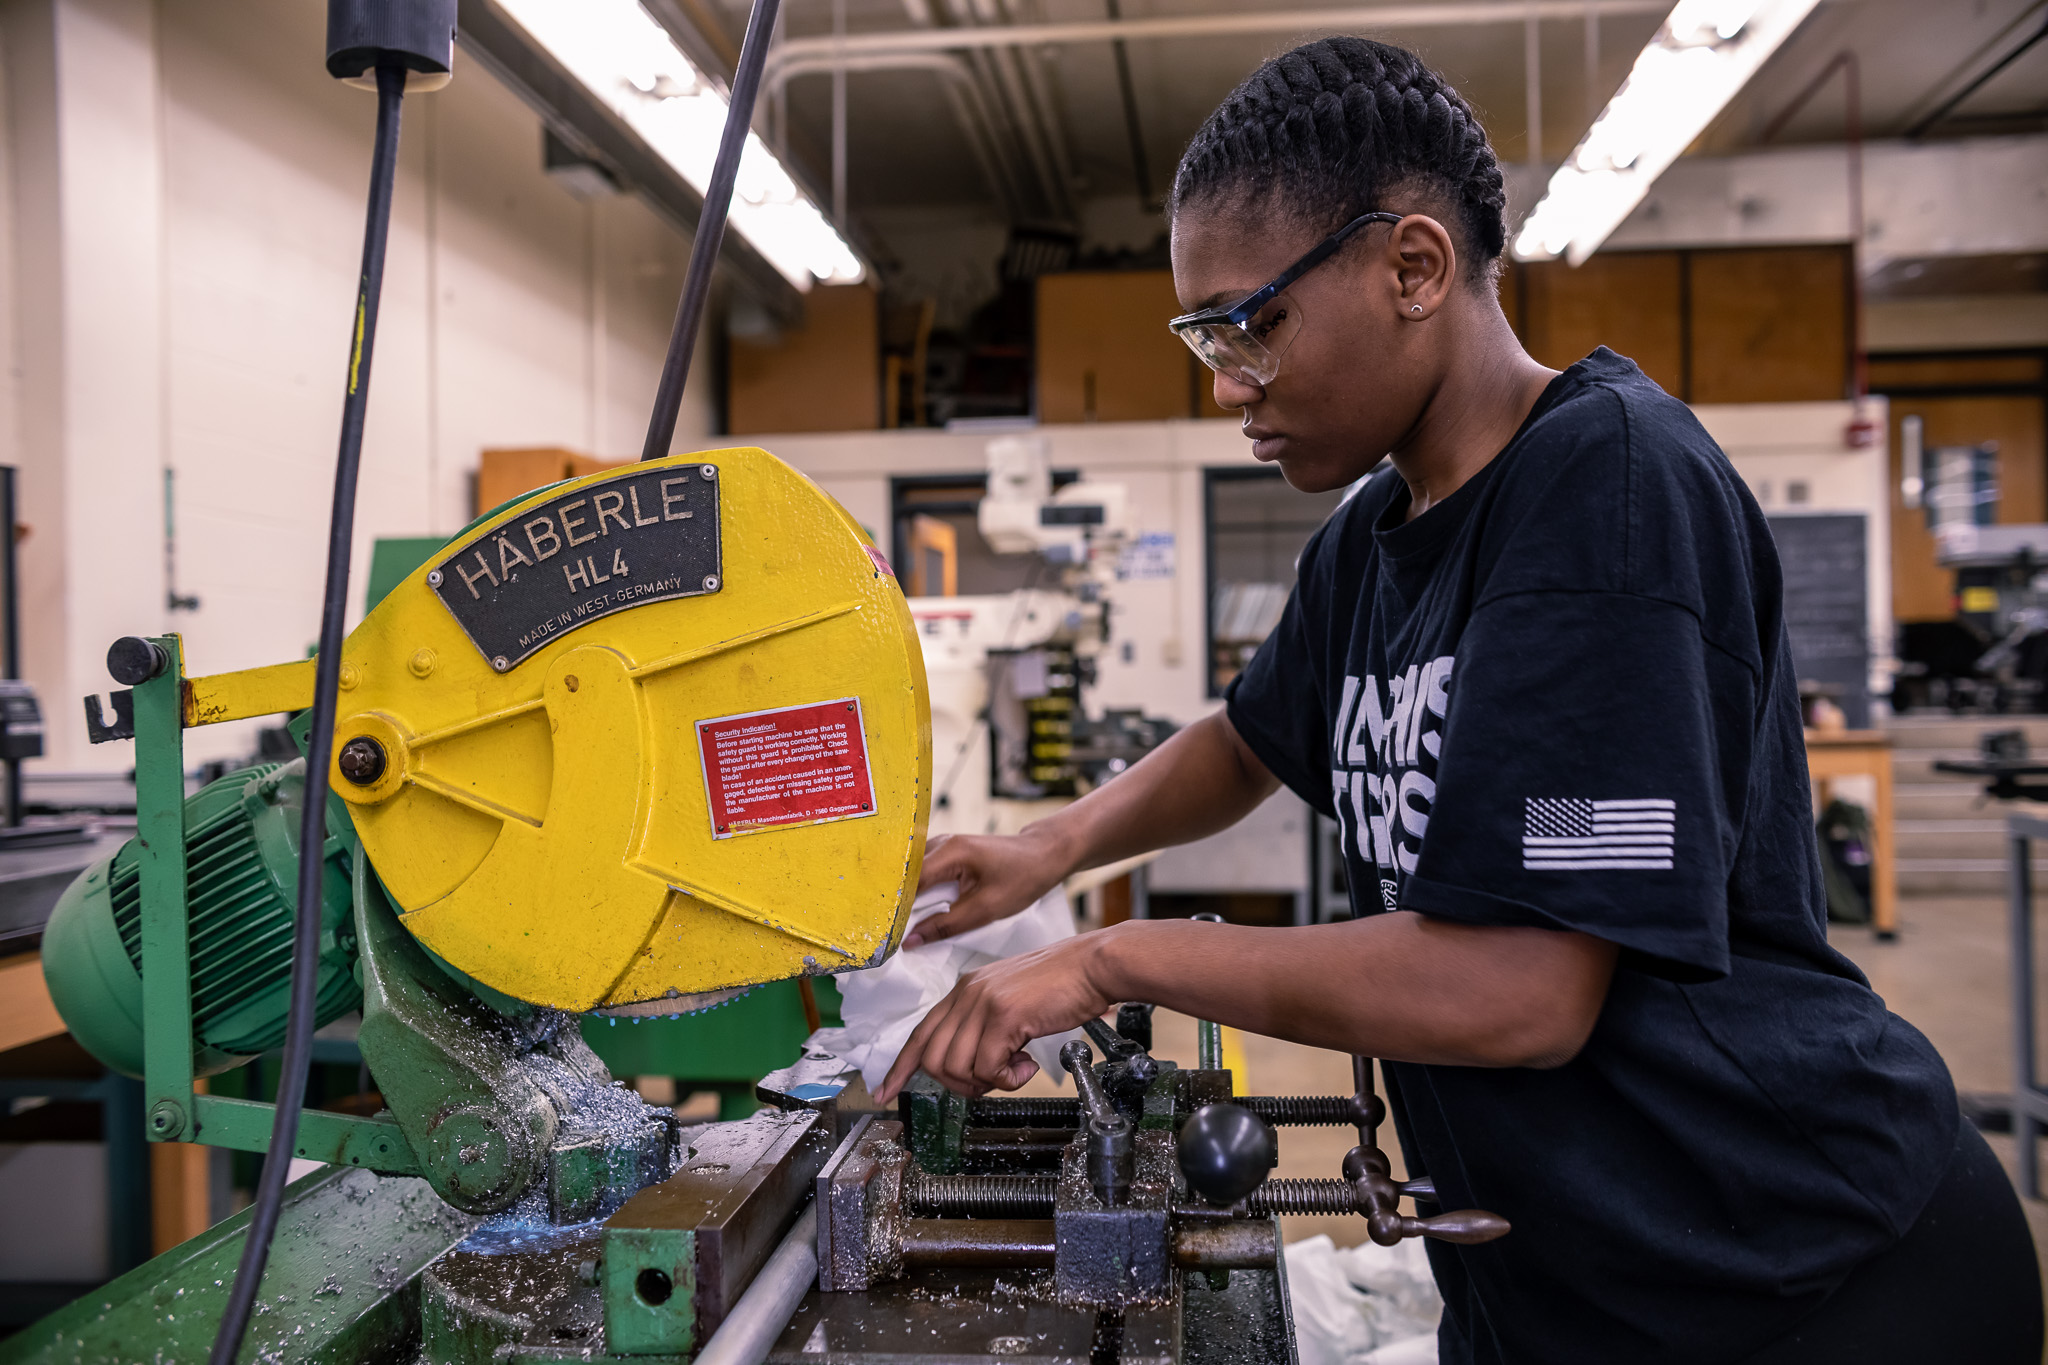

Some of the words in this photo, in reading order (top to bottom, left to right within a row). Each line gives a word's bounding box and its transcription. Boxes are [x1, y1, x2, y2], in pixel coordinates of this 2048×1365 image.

[456, 476, 693, 600] HÄBERLE
[562, 548, 629, 594] HL4
[519, 619, 557, 649] MADE
[556, 611, 572, 631] IN
[573, 577, 682, 618] WEST-GERMANY
[715, 729, 740, 738] Security
[742, 722, 776, 733] Indication!
[717, 741, 737, 749] Before
[739, 737, 763, 745] starting
[765, 732, 792, 741] machine
[718, 749, 737, 757] safety
[738, 745, 756, 755] guard
[764, 741, 789, 750] working
[790, 736, 819, 745] correctly.
[820, 732, 847, 741] Working
[719, 756, 743, 765] without
[761, 749, 779, 760] guard
[791, 743, 825, 755] prohibited.
[828, 739, 848, 748] Check
[732, 763, 750, 773] guard
[785, 754, 814, 763] changing
[721, 772, 742, 782] blade!
[724, 789, 746, 799] gaged,
[747, 785, 776, 794] defective
[786, 780, 811, 788] missing
[813, 776, 833, 784] safety
[835, 772, 854, 782] guard
[765, 773, 792, 783] accident
[793, 769, 816, 779] caused
[738, 792, 780, 804] manufacturer
[805, 784, 833, 794] machine
[726, 806, 746, 815] liable.
